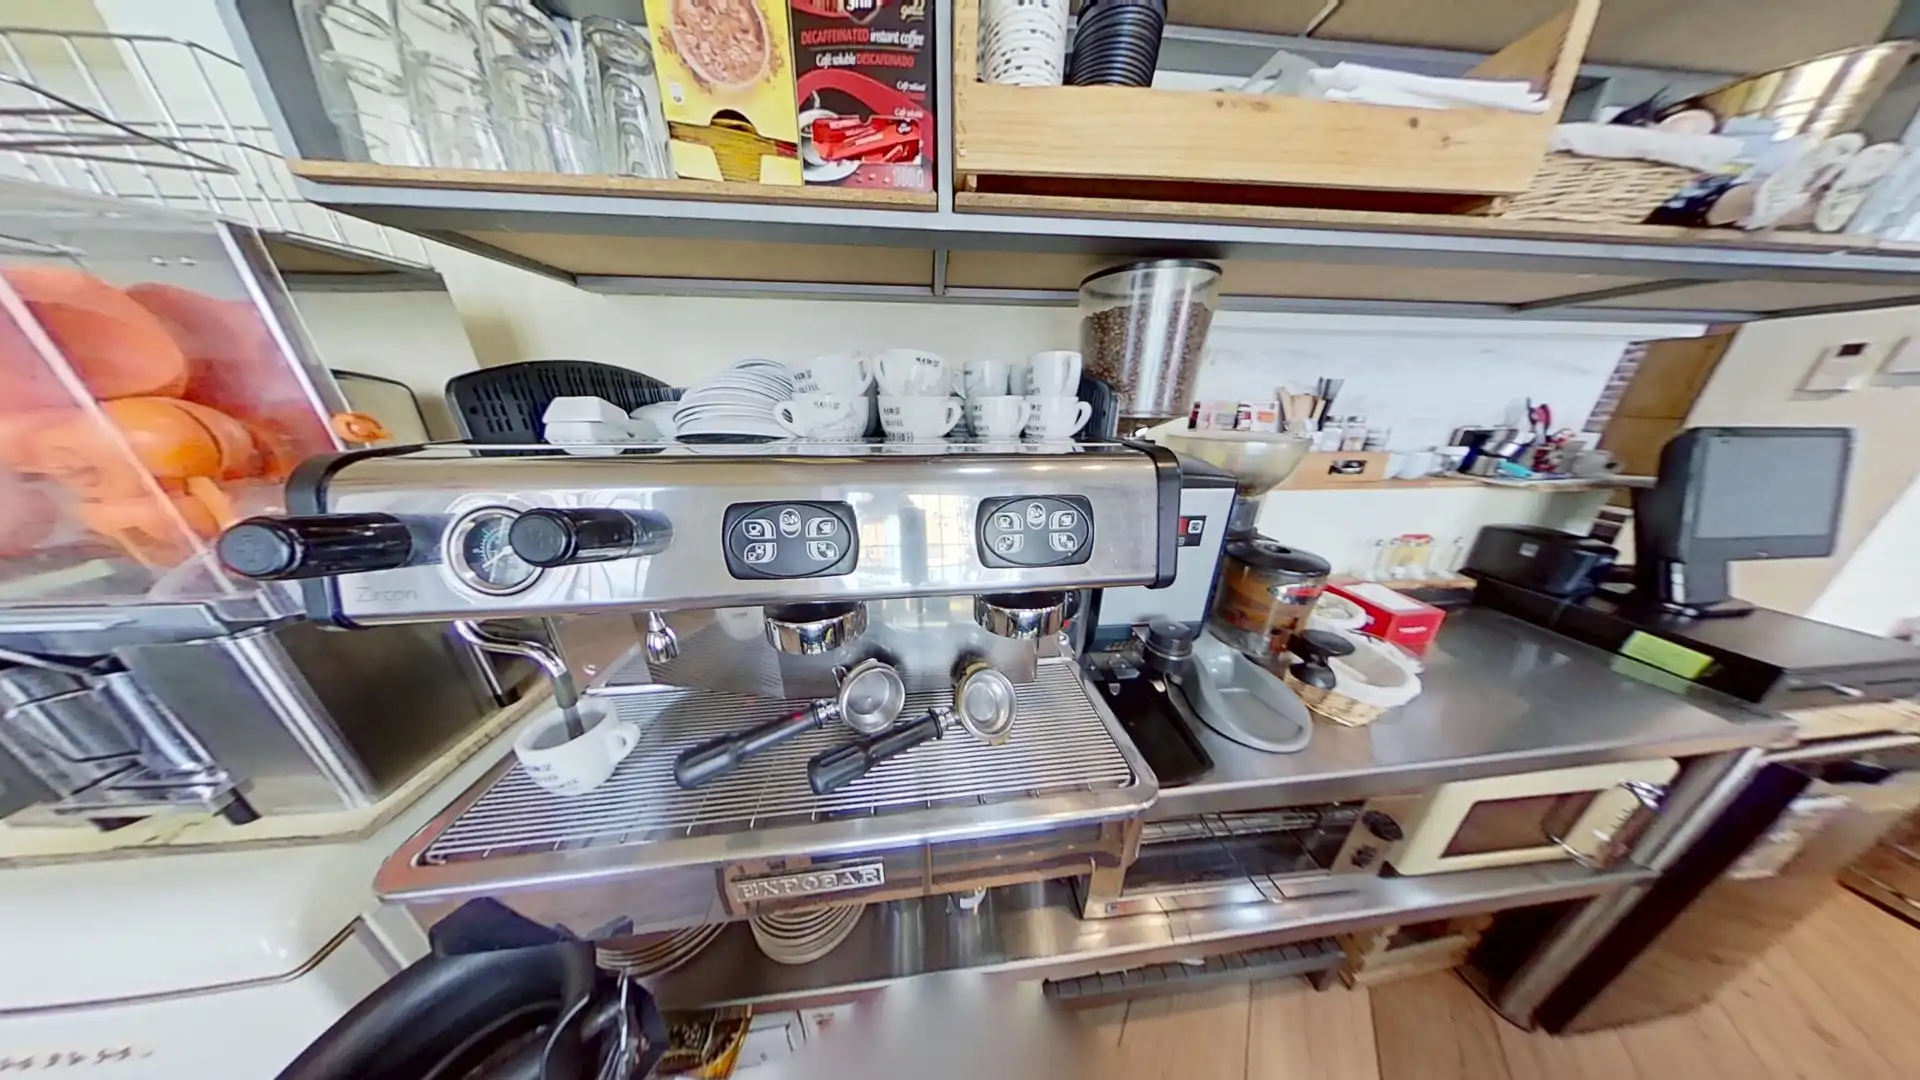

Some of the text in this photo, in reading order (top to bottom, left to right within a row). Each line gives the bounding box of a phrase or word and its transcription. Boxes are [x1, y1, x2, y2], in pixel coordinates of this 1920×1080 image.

[801, 28, 925, 48] DECAFFEINATED instant coffee
[832, 52, 856, 66] soluble
[857, 54, 915, 68] DESCAFEINADO
[738, 868, 880, 898] EXPOBAR
